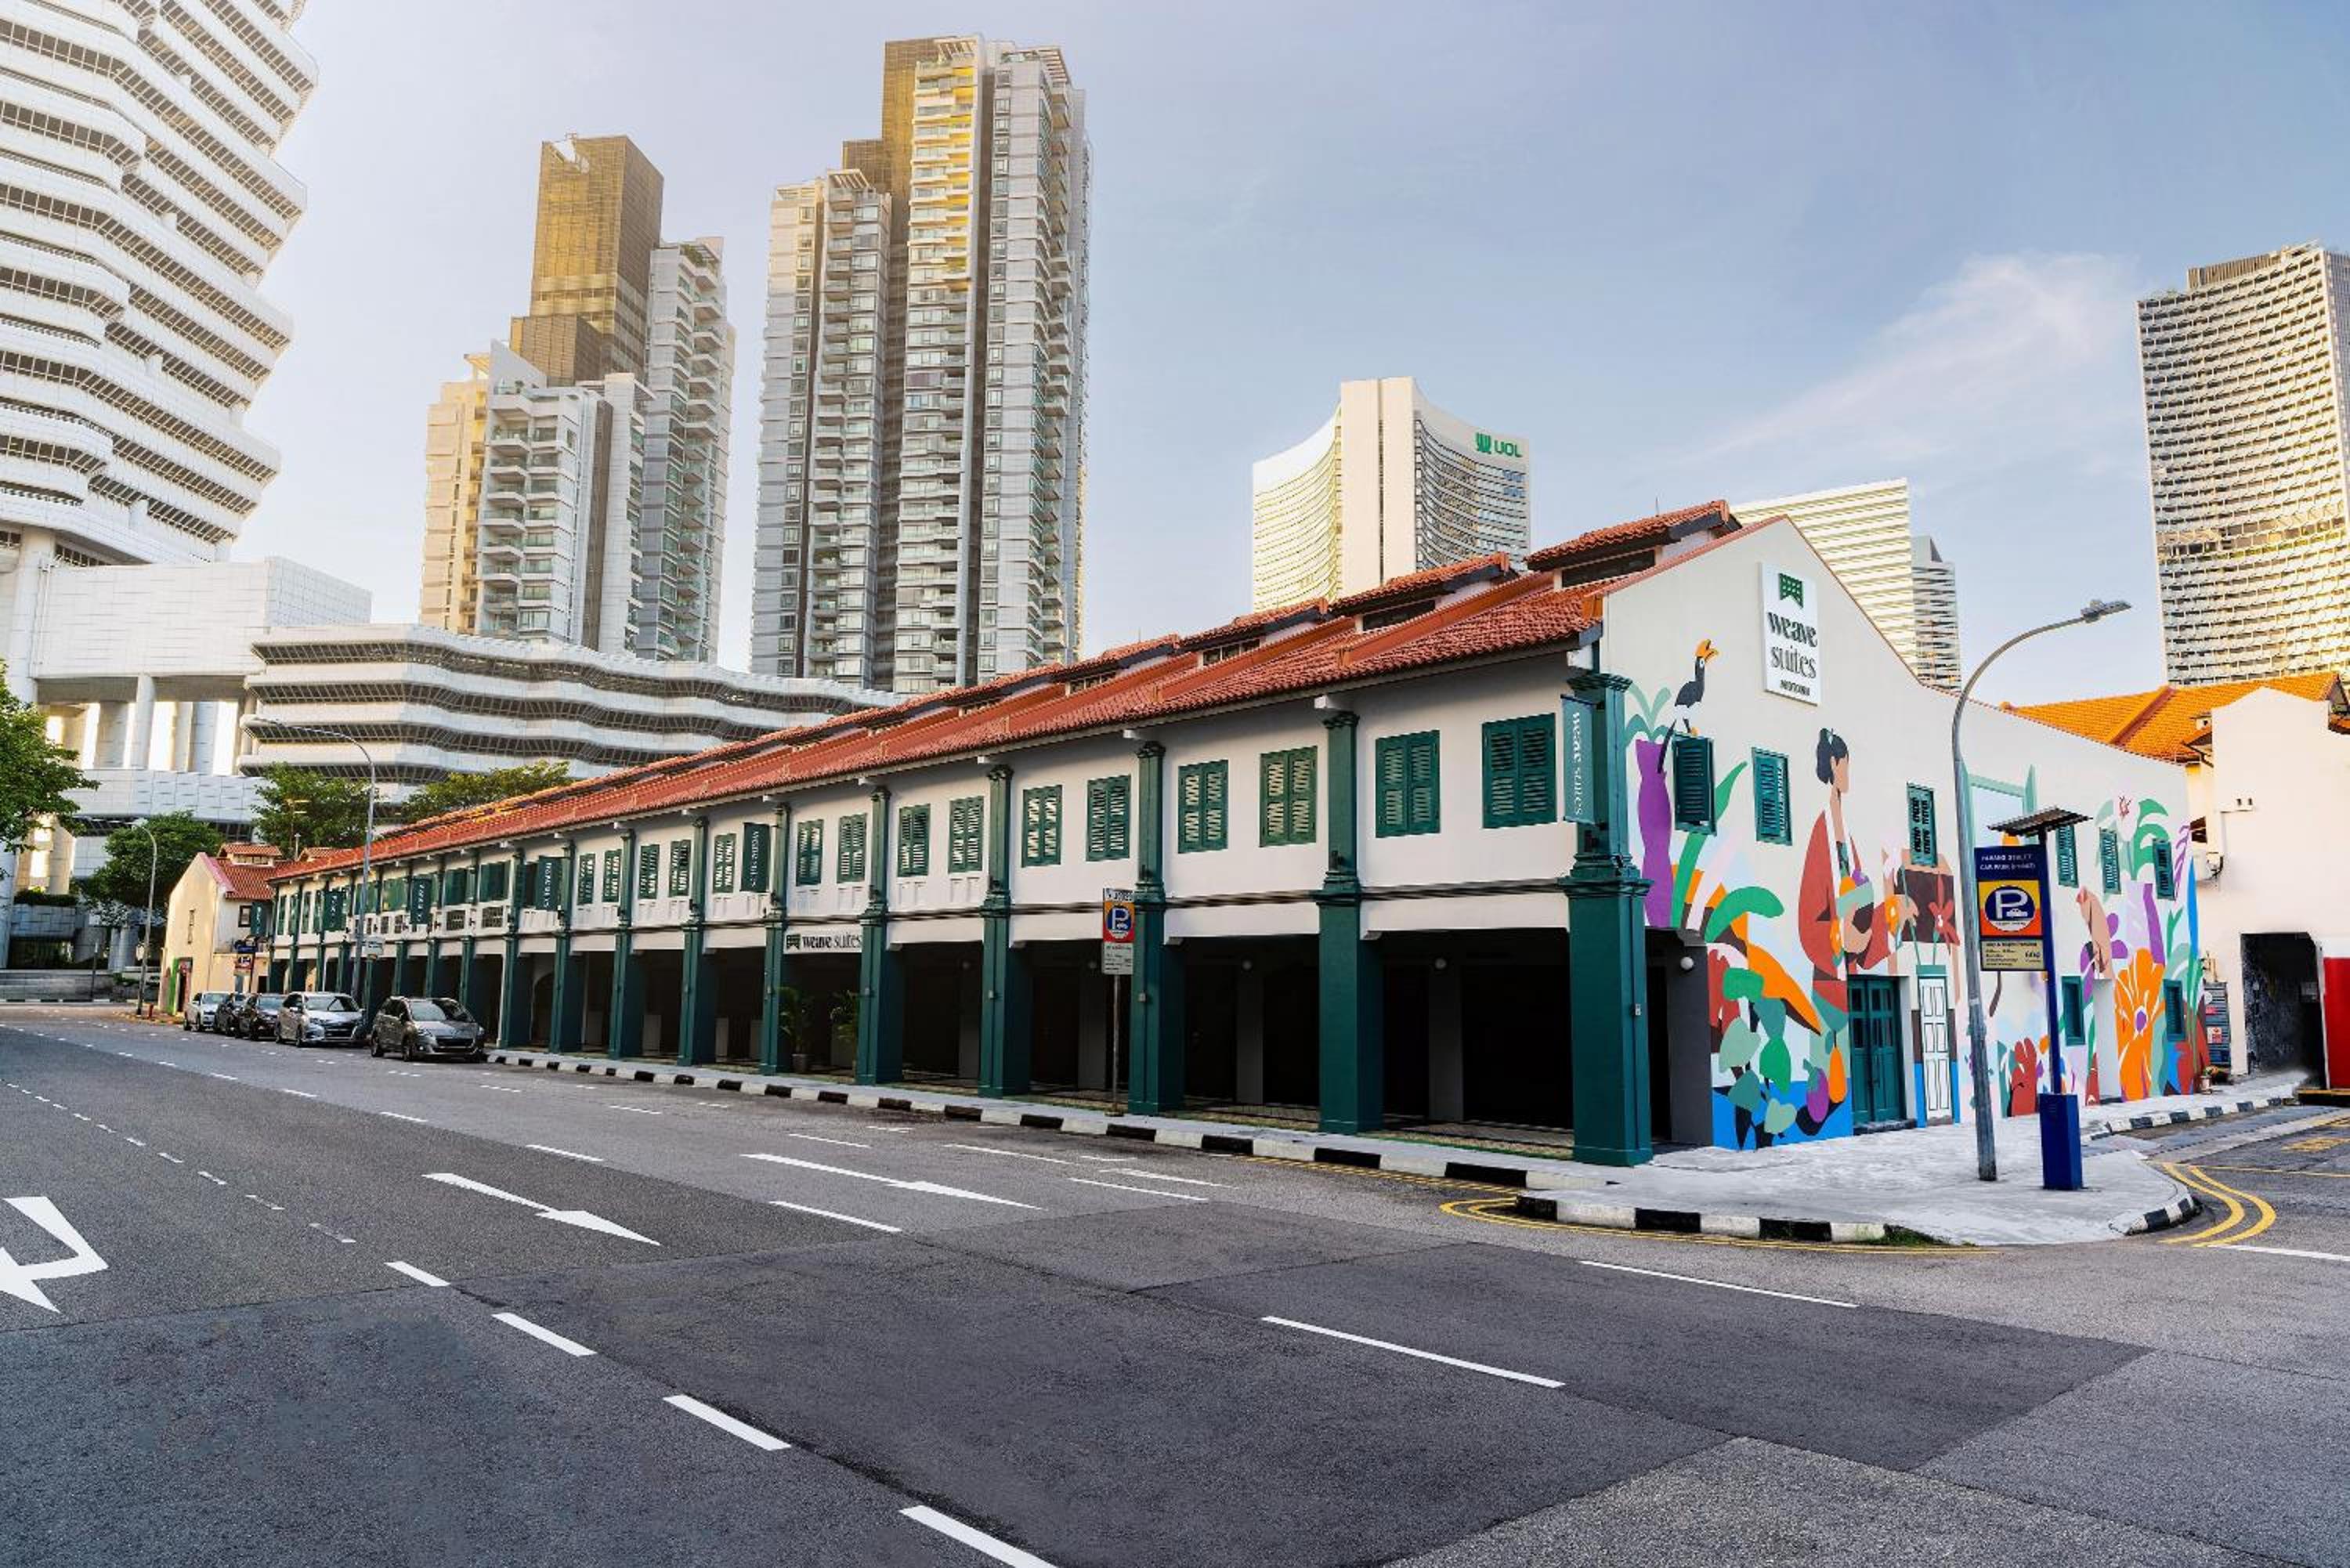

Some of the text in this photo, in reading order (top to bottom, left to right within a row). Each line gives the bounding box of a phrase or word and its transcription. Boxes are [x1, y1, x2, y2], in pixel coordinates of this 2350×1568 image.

[1495, 439, 1523, 458] UOL
[1766, 612, 1818, 648] weave
[1770, 645, 1817, 679] suites
[1995, 889, 2028, 919] P
[1112, 907, 1130, 930] P
[802, 936, 831, 948] weave
